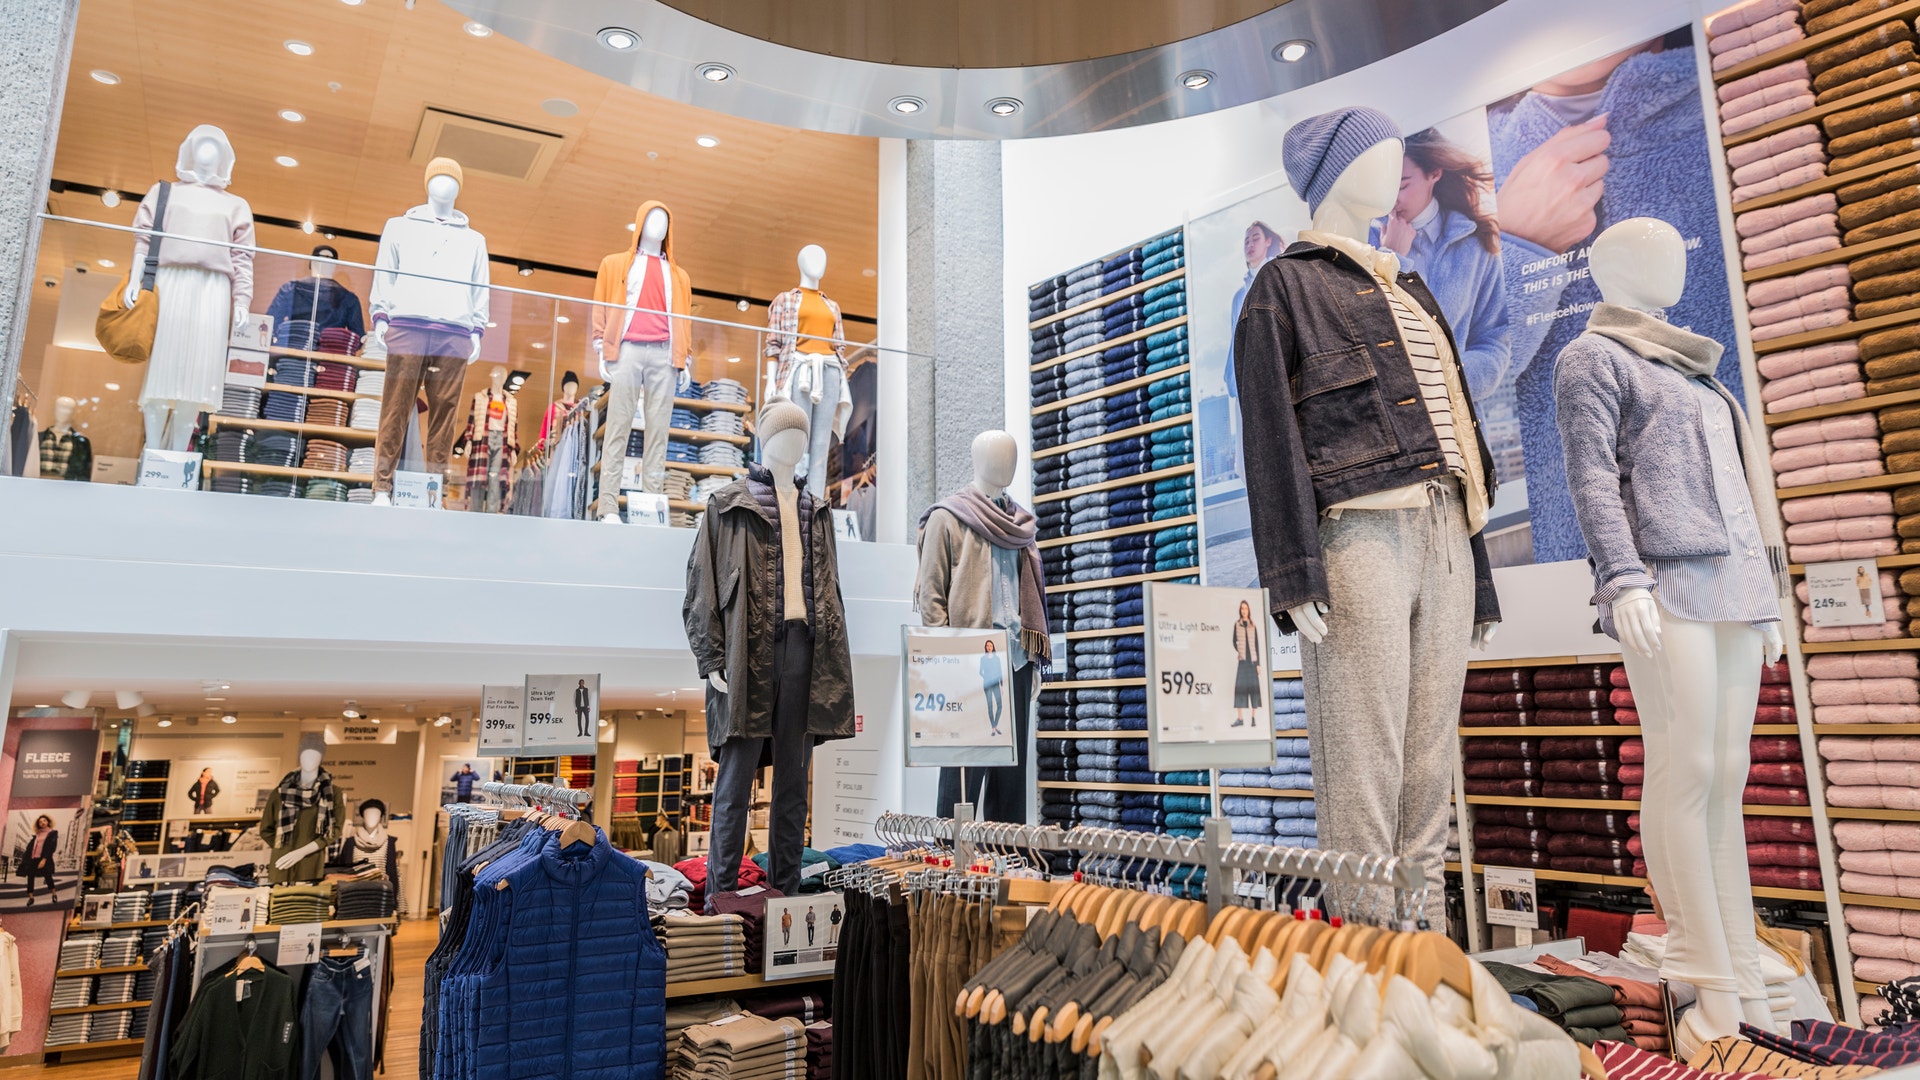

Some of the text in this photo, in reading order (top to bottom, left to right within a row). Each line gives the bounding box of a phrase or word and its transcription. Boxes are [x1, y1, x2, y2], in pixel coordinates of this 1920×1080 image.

[1521, 250, 1576, 276] COMFORT
[1577, 246, 1591, 260] AN
[1523, 266, 1590, 294] THIS IS THE
[1526, 301, 1595, 326] #FleeceNow
[1158, 621, 1220, 633] Ultra Light Down
[1159, 634, 1174, 643] Vest
[1280, 643, 1297, 654] and
[912, 655, 960, 665] Leggings Pants
[25, 752, 72, 763] FLEECE
